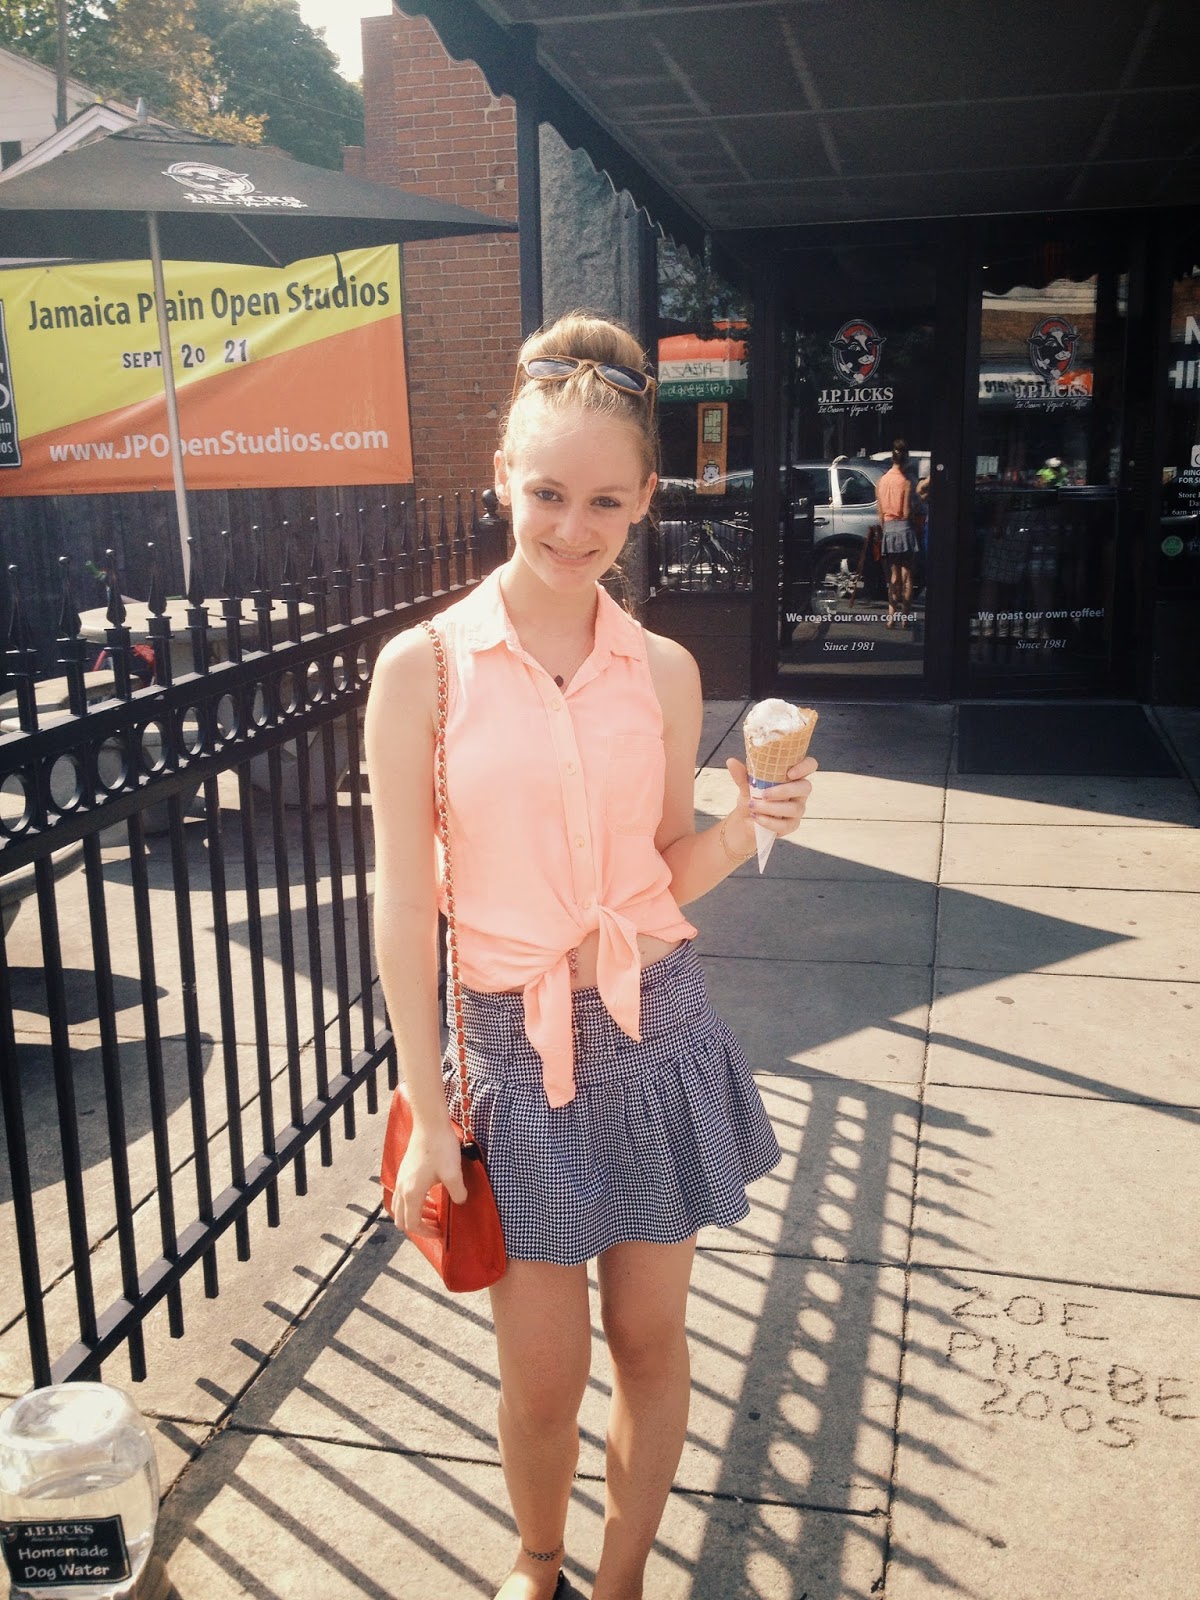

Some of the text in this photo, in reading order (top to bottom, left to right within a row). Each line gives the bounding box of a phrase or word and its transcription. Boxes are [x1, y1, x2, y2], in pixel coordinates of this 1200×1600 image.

[28, 275, 390, 331] Jamaica Pain Open Studios
[122, 339, 247, 369] SEPT 20 21
[843, 386, 894, 402] LICKS
[1041, 384, 1088, 398] LICKS
[785, 611, 917, 622] We roast our own coffee!
[978, 608, 1105, 621] We roast our own coffee!
[823, 641, 875, 651] Since 1981
[1016, 639, 1067, 650] Since 1981
[951, 1286, 1109, 1340] ZOE
[48, 1525, 94, 1536] LICKS
[18, 1544, 109, 1560] Homemade
[24, 1563, 110, 1580] Dog Water
